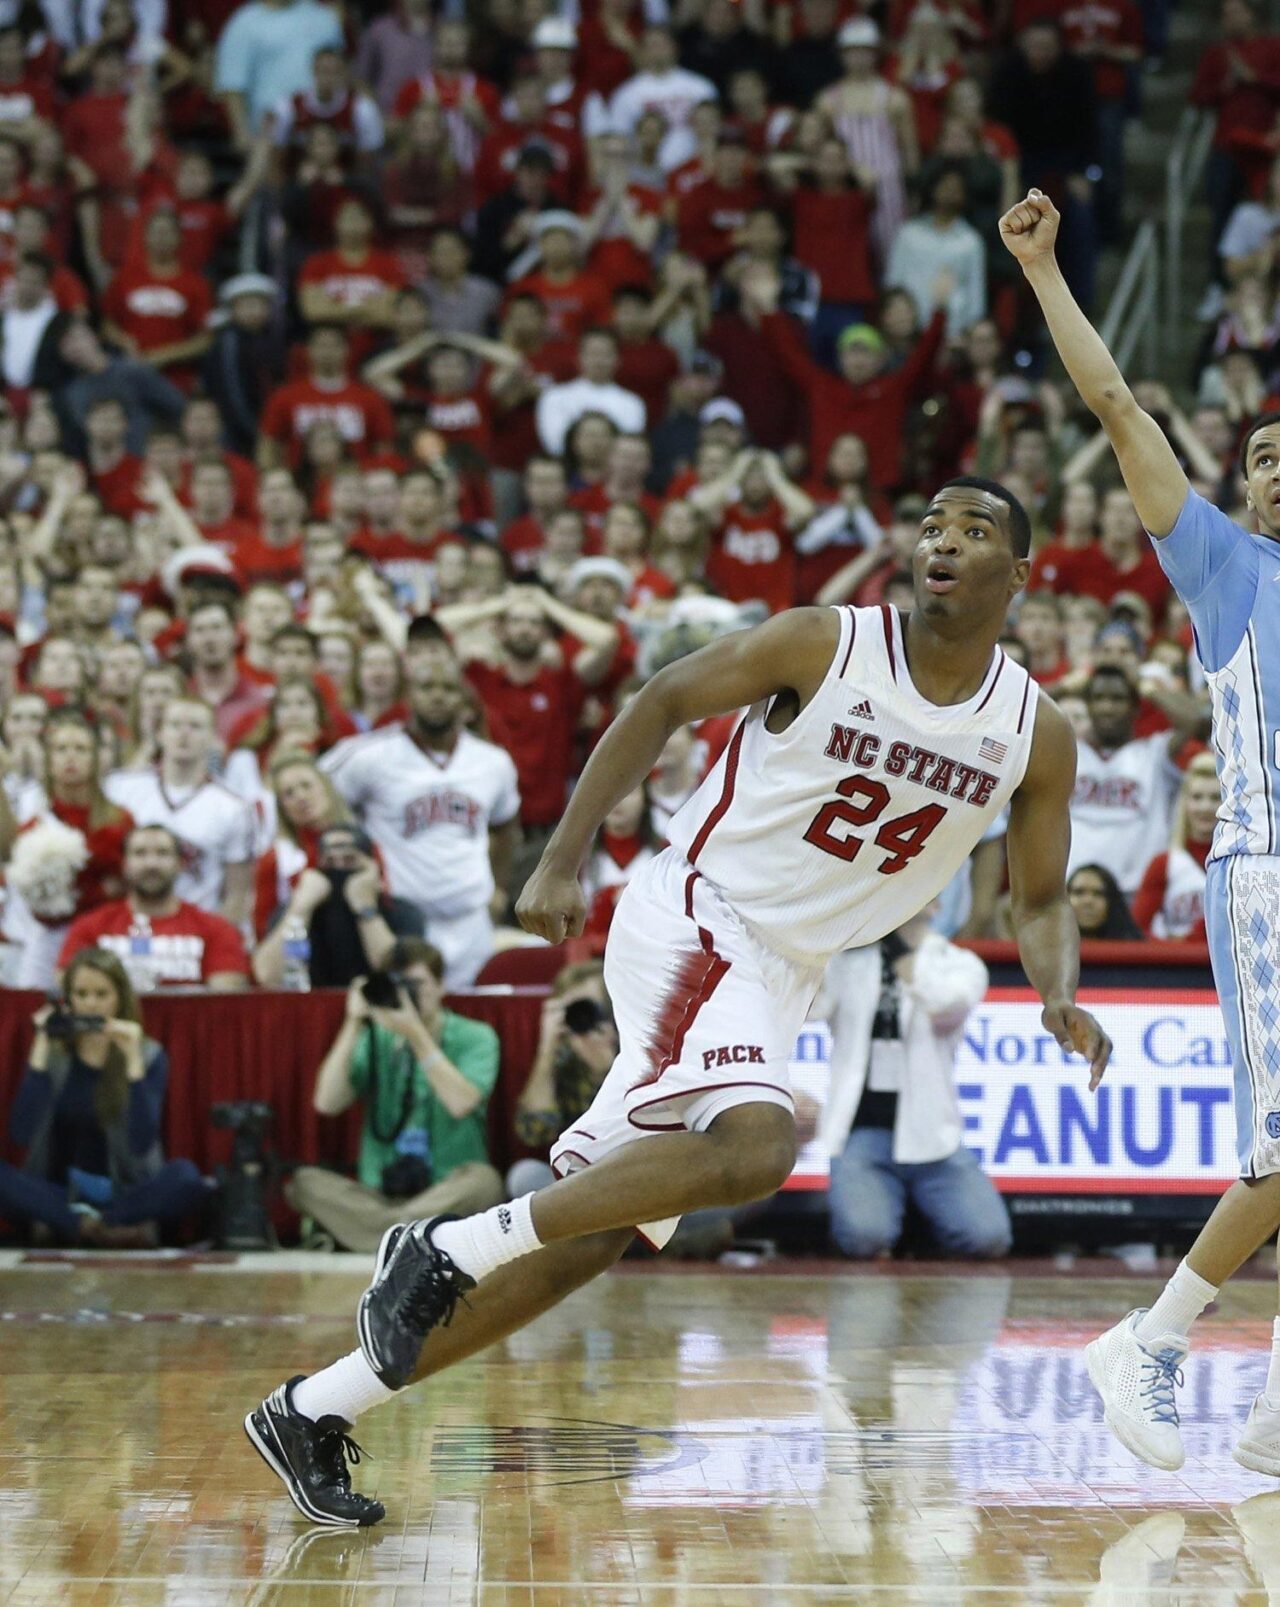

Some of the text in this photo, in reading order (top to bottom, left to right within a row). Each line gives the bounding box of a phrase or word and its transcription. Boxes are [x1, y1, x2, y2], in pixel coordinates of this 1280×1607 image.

[848, 709, 875, 721] adidas
[824, 723, 1000, 808] NC STATE
[803, 774, 948, 875] 24
[702, 1045, 766, 1071] PACK
[965, 1017, 1112, 1064] Nor
